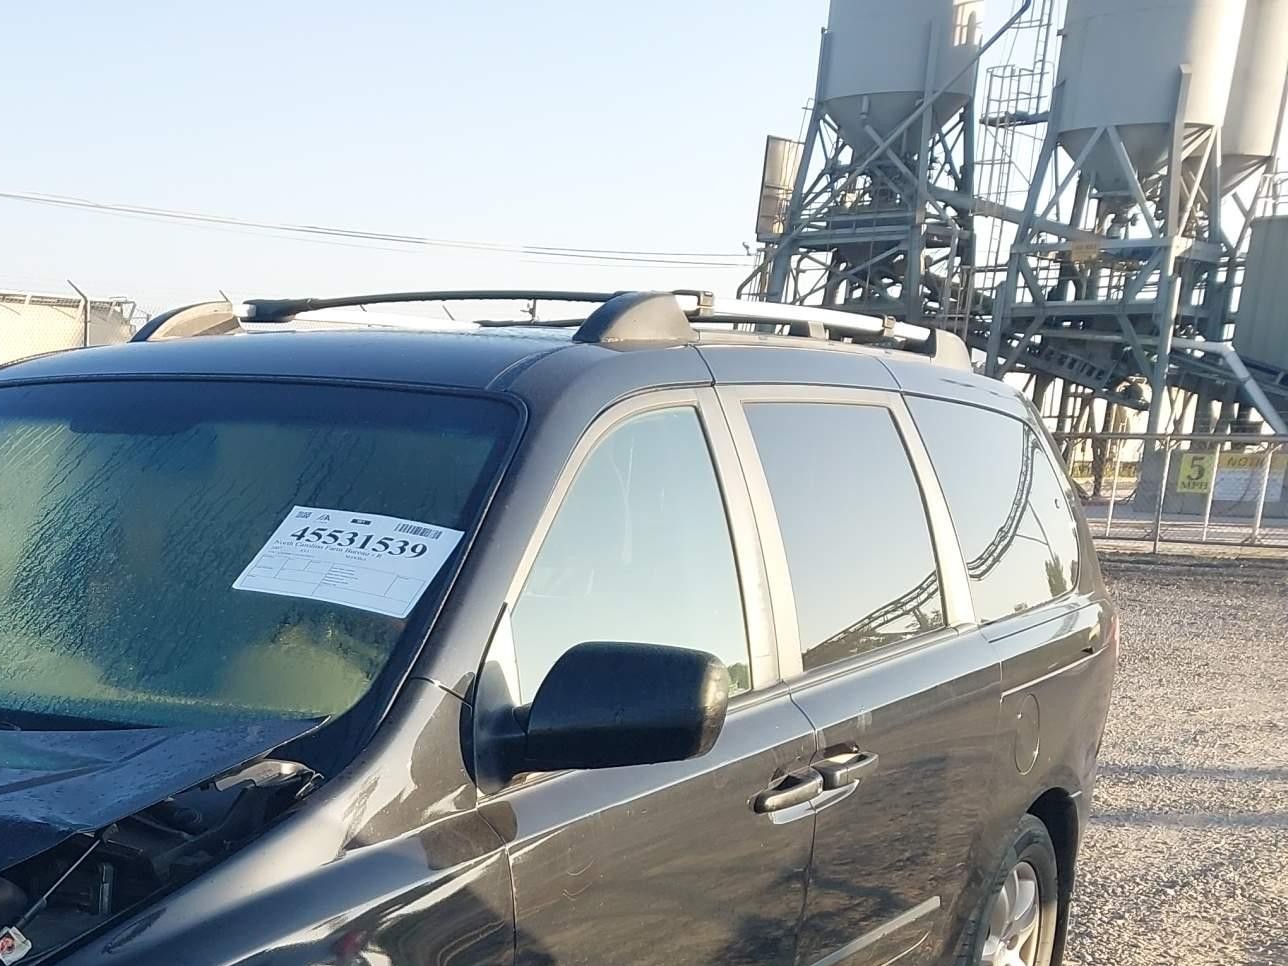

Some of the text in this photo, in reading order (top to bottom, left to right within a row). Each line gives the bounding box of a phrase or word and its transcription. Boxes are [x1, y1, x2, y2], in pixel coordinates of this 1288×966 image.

[1187, 456, 1205, 480] 5
[1181, 481, 1208, 490] MPH
[290, 525, 428, 559] 45531539
